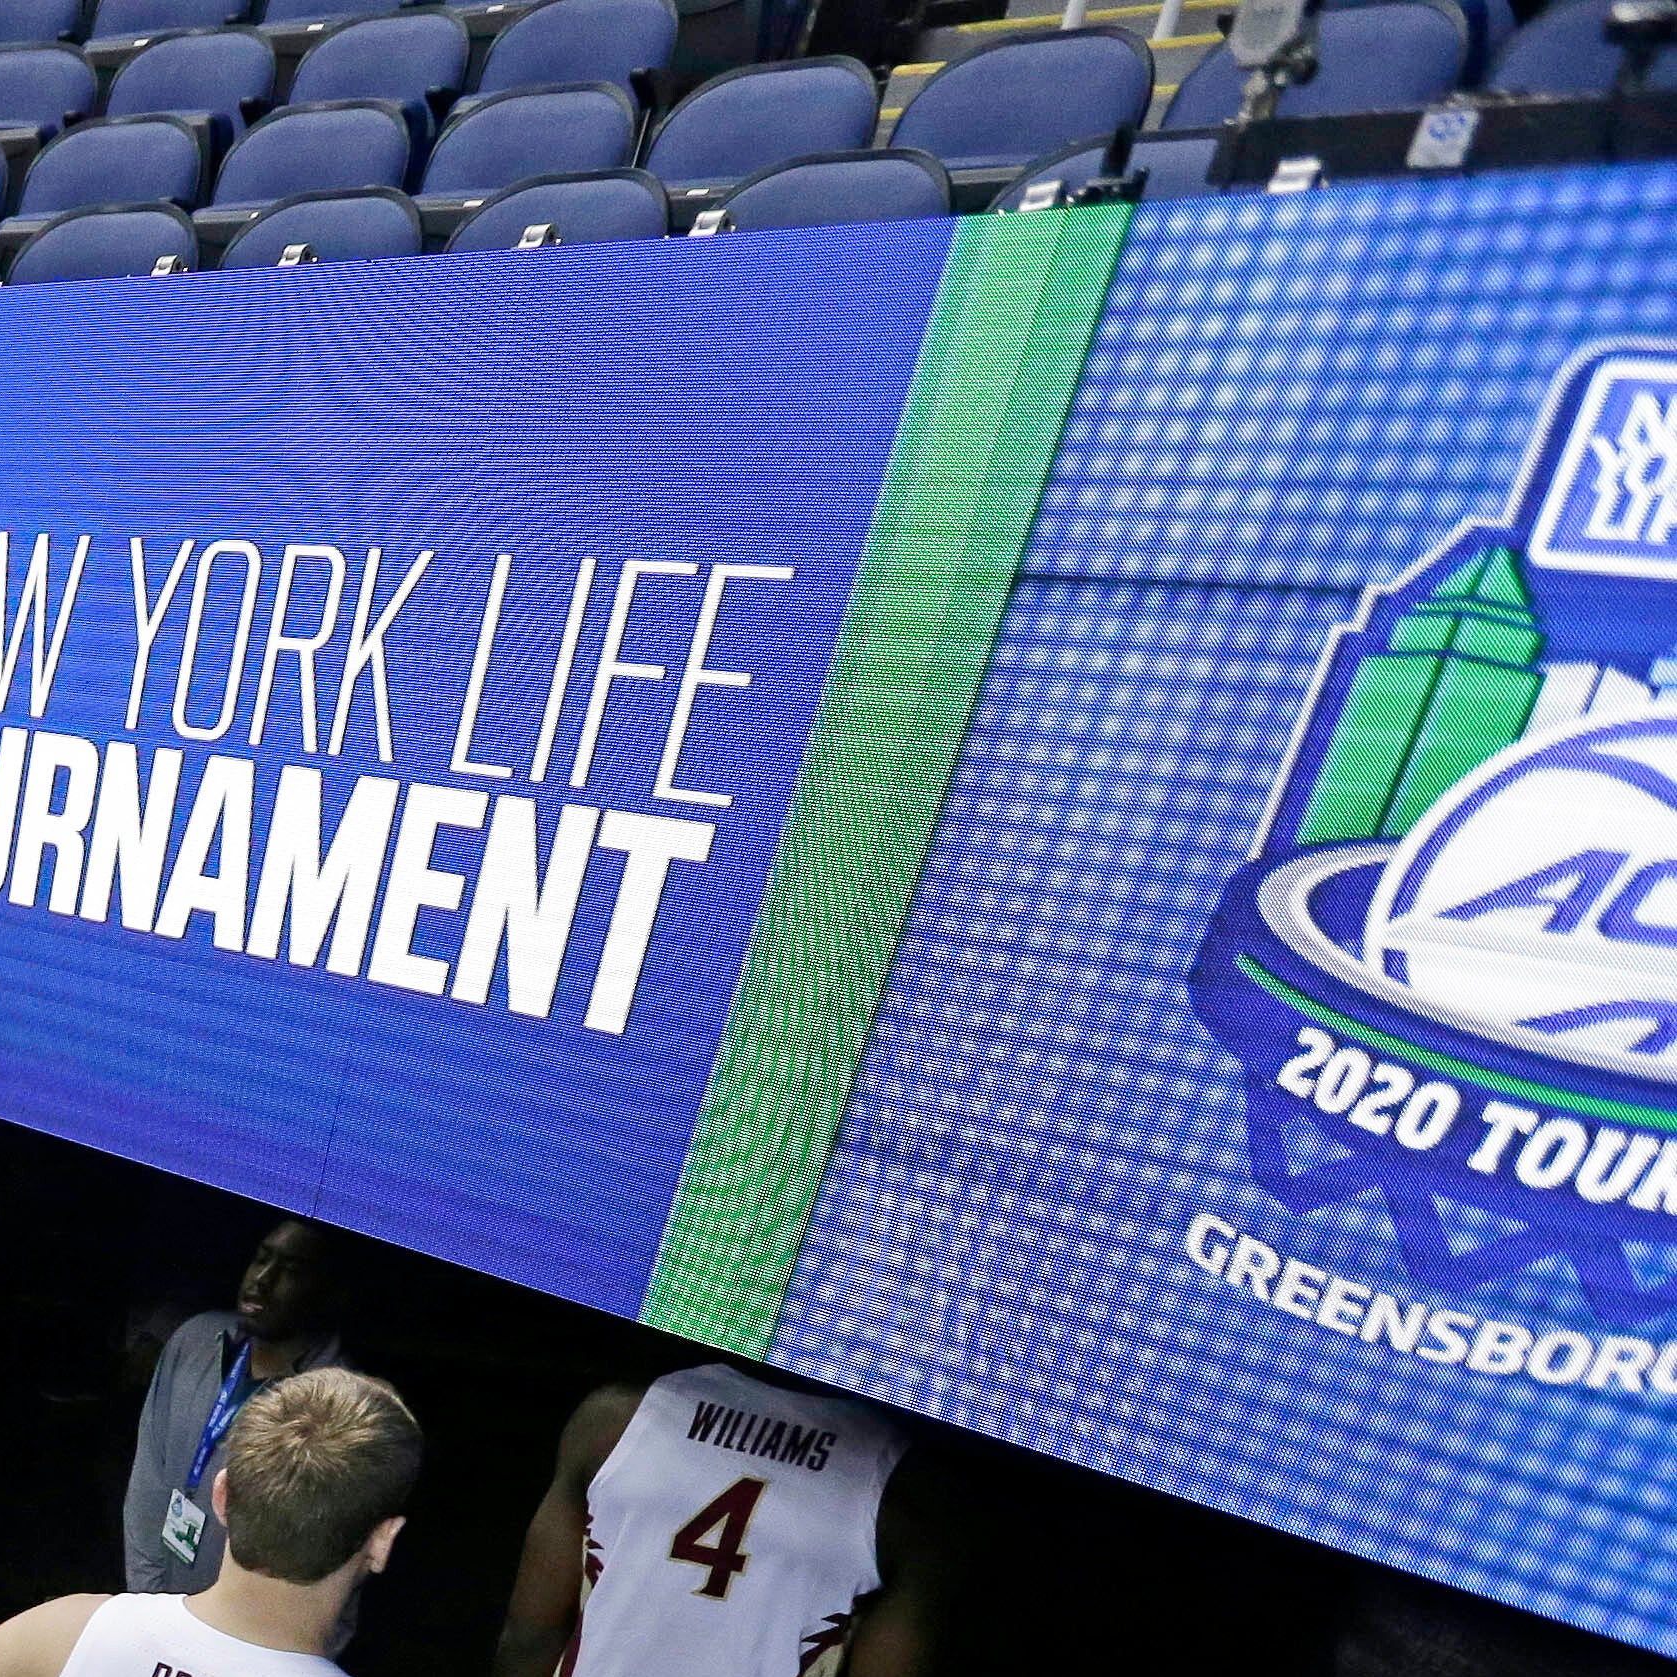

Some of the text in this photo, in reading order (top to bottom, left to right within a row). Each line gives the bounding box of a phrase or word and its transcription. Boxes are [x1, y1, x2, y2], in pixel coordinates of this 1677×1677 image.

[124, 537, 435, 763] YORK
[449, 554, 794, 807] LIFE
[1277, 1026, 1460, 1152] 2020
[686, 1400, 837, 1472] WILLIAMS
[667, 1475, 769, 1602] 4
